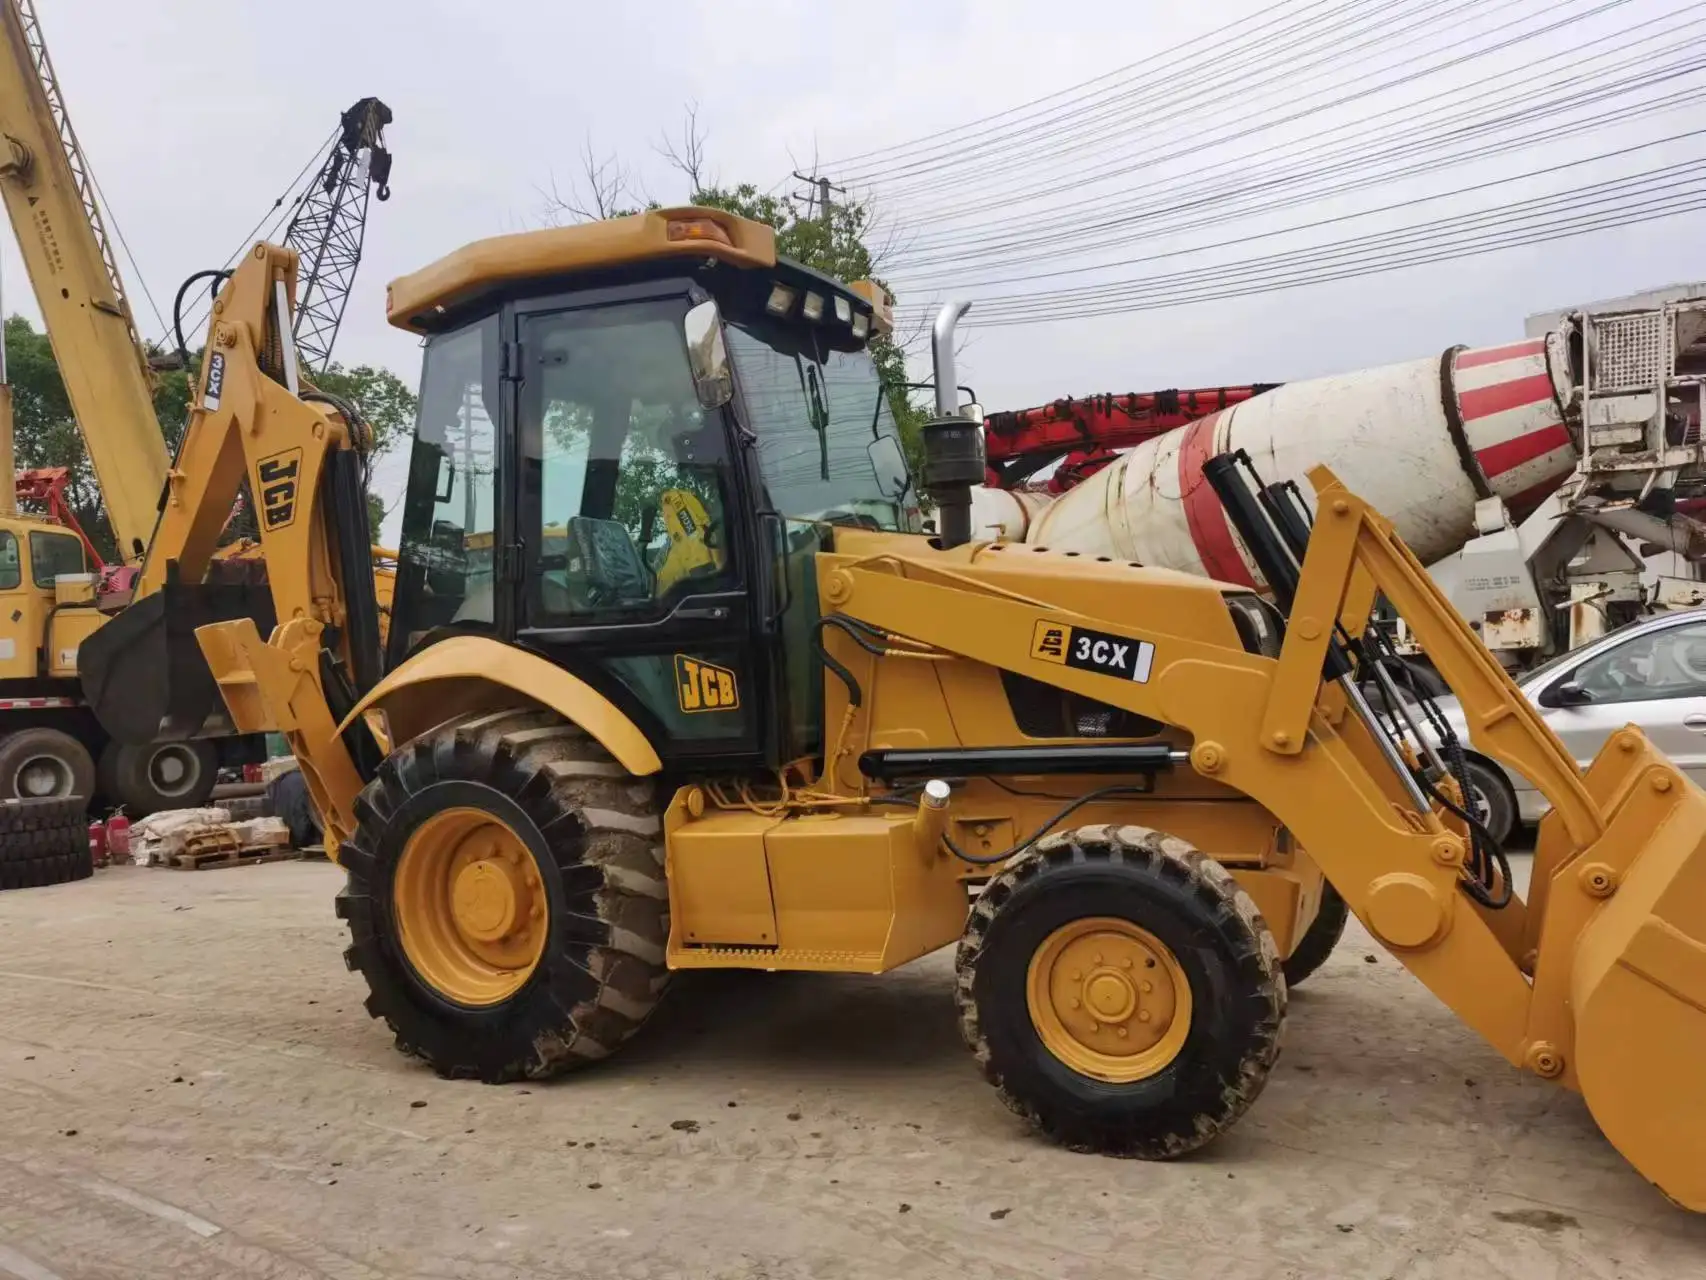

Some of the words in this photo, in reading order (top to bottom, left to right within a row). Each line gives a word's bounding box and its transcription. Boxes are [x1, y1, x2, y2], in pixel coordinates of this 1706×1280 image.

[260, 459, 298, 526] JCB
[1038, 629, 1063, 656] JCB
[1075, 636, 1129, 669] 3CX
[682, 660, 735, 709] JCB
